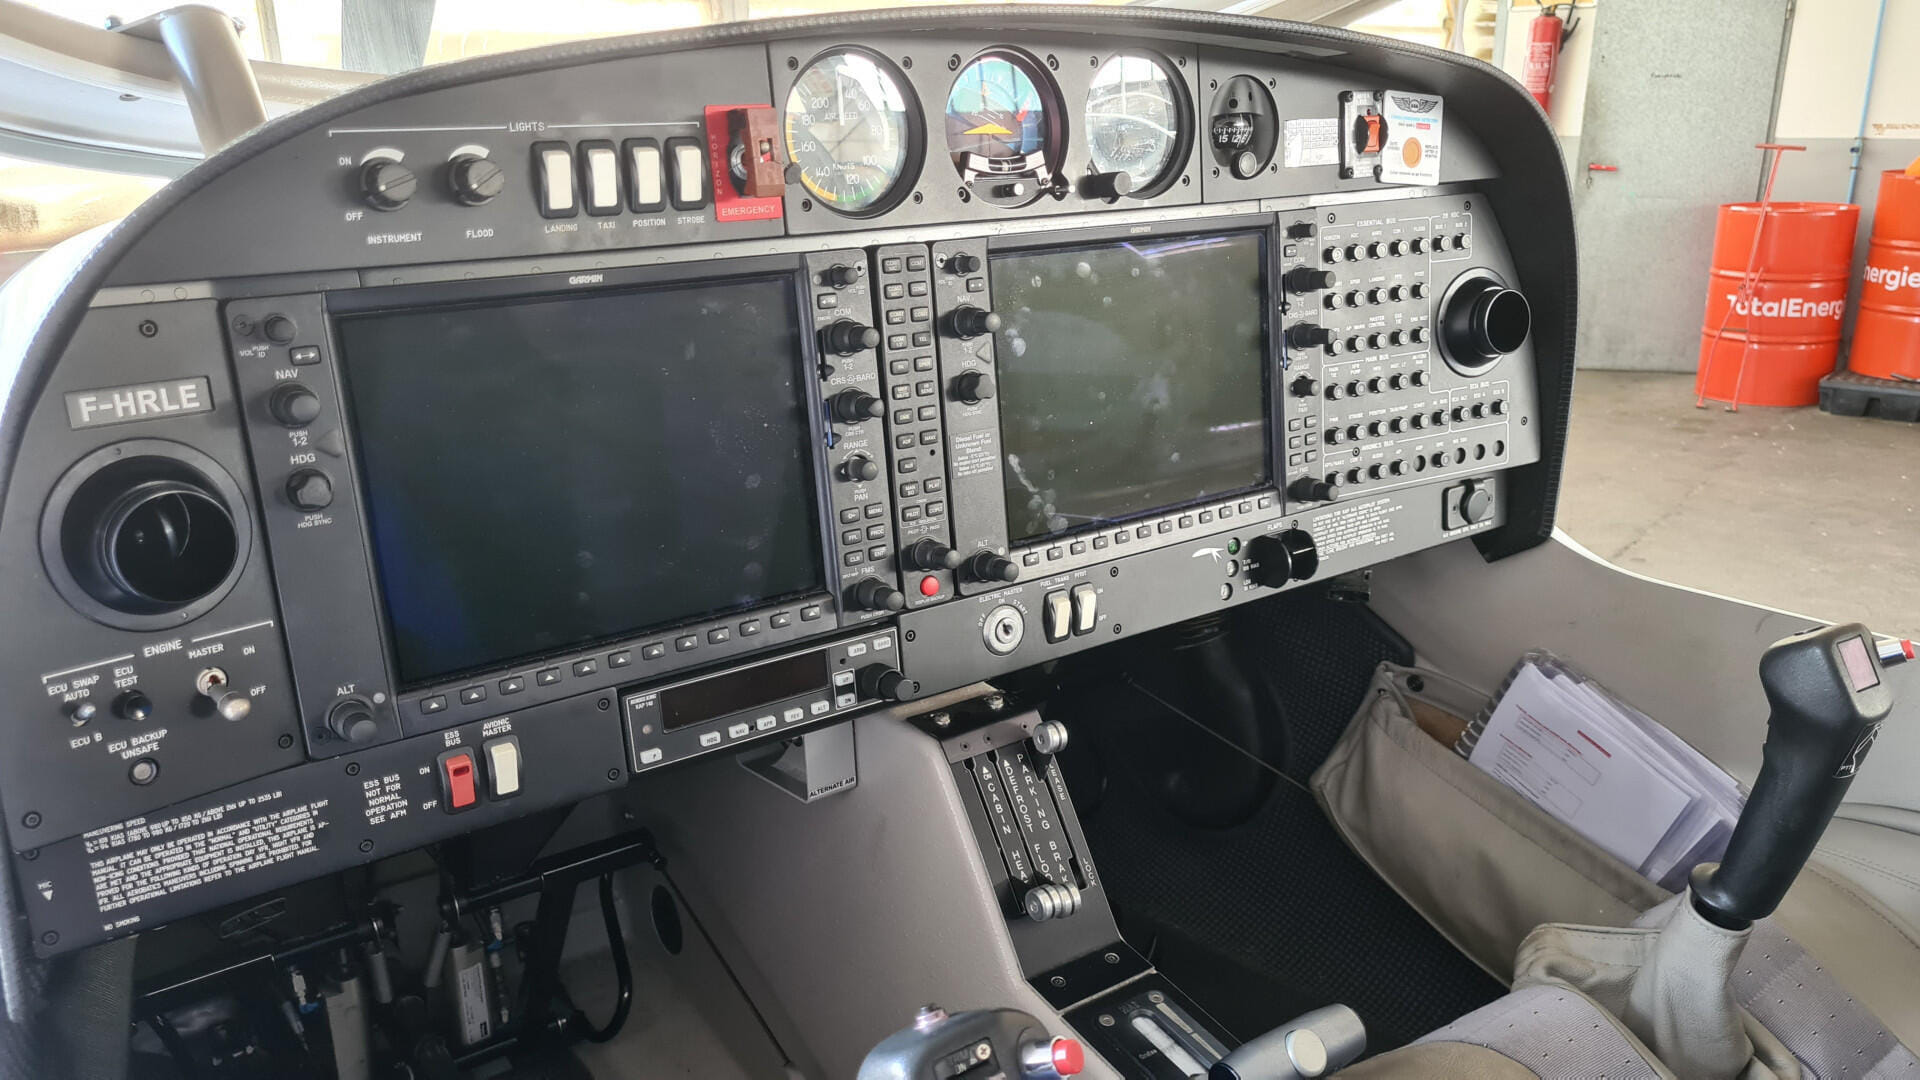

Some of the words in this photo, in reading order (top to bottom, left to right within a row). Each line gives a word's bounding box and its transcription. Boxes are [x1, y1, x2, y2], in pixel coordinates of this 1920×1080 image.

[811, 97, 829, 109] 200
[824, 111, 857, 120] AIREED
[508, 122, 545, 133] LIGHTS
[801, 141, 816, 151] 160
[339, 157, 352, 166] ON
[862, 155, 877, 166] 100
[815, 167, 830, 177] 140
[846, 173, 859, 184] 120
[345, 212, 363, 221] OFF
[721, 204, 776, 217] EMERGENCY
[597, 221, 616, 230] TAXI
[632, 217, 666, 228] POSITION
[677, 215, 705, 225] STROBE
[466, 229, 494, 239] FLOOD
[544, 223, 578, 234] LANDING
[367, 232, 423, 244] INSTRUMENT
[569, 273, 604, 285] GARMIN
[275, 369, 299, 380] NAV
[78, 384, 201, 422] F-HRLE
[289, 430, 308, 438] PUSH
[292, 437, 308, 447] 1-2
[843, 439, 868, 450] RANGE
[290, 453, 316, 465] HDG
[854, 491, 869, 502] PAN
[143, 640, 183, 658] ENGINE
[188, 644, 225, 660] MASTER
[243, 646, 256, 656] ON
[114, 665, 134, 678] ECU
[48, 683, 68, 696] ECU
[73, 675, 100, 689] SWAP
[114, 676, 139, 689] TEST
[64, 689, 90, 703] AUTO
[250, 685, 267, 697] OFF
[336, 684, 356, 697] ALT
[483, 717, 511, 730] AVIONIC
[444, 730, 460, 741] ESS
[482, 724, 512, 738] MASTER
[70, 736, 91, 749] ECU
[94, 732, 103, 743] B
[108, 741, 128, 754] ECU
[131, 728, 168, 747] BACKUP
[445, 736, 461, 748] BUS
[122, 742, 160, 760] UNSAFE
[419, 766, 431, 775] ON
[363, 779, 380, 790] ESS
[383, 774, 401, 785] BUS
[809, 780, 844, 797] ALTERNATE
[844, 777, 855, 785] AIR
[365, 788, 381, 799] NOT
[386, 783, 402, 795] FOR
[1017, 753, 1050, 830] PARKING
[368, 793, 401, 808] NORMAL
[423, 800, 438, 811] OFF
[365, 799, 409, 818] OPERATION
[369, 815, 387, 826] SEE
[390, 809, 407, 821] AFM
[1005, 766, 1034, 833] DEFROST
[1034, 843, 1053, 881] FLOO
[988, 782, 1012, 835] CABIN
[1012, 850, 1029, 884] HEA
[1083, 857, 1097, 888] LOCK
